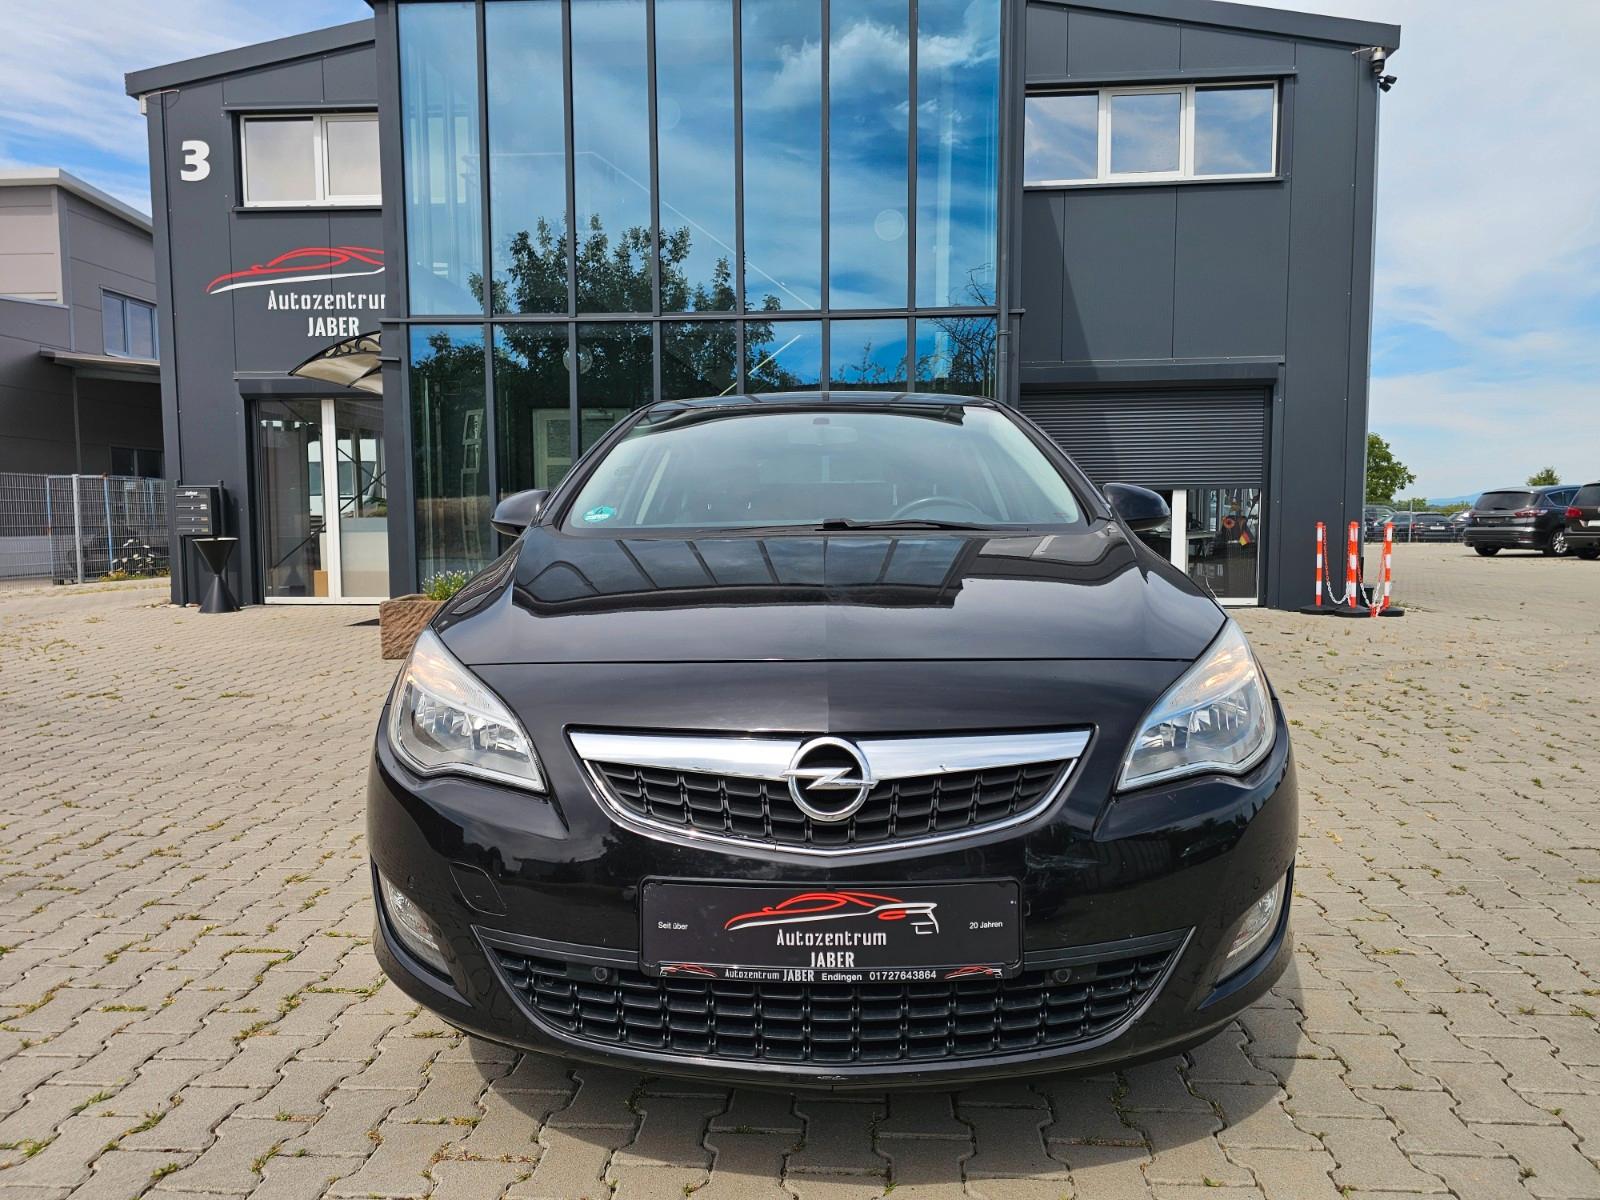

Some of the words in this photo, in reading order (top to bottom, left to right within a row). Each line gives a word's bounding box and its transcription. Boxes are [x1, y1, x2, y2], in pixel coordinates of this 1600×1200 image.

[180, 139, 211, 182] 3
[307, 316, 360, 337] JABER
[657, 921, 672, 930] Seit
[672, 921, 689, 931] über
[969, 921, 979, 930] 20
[980, 920, 1003, 930] Jahren
[776, 928, 888, 947] Autozentrum
[809, 951, 856, 969] JABER
[724, 968, 780, 980] Autozentrum
[782, 969, 815, 982] JABER
[821, 972, 863, 983] Endingen
[869, 970, 937, 981] 01727643864
